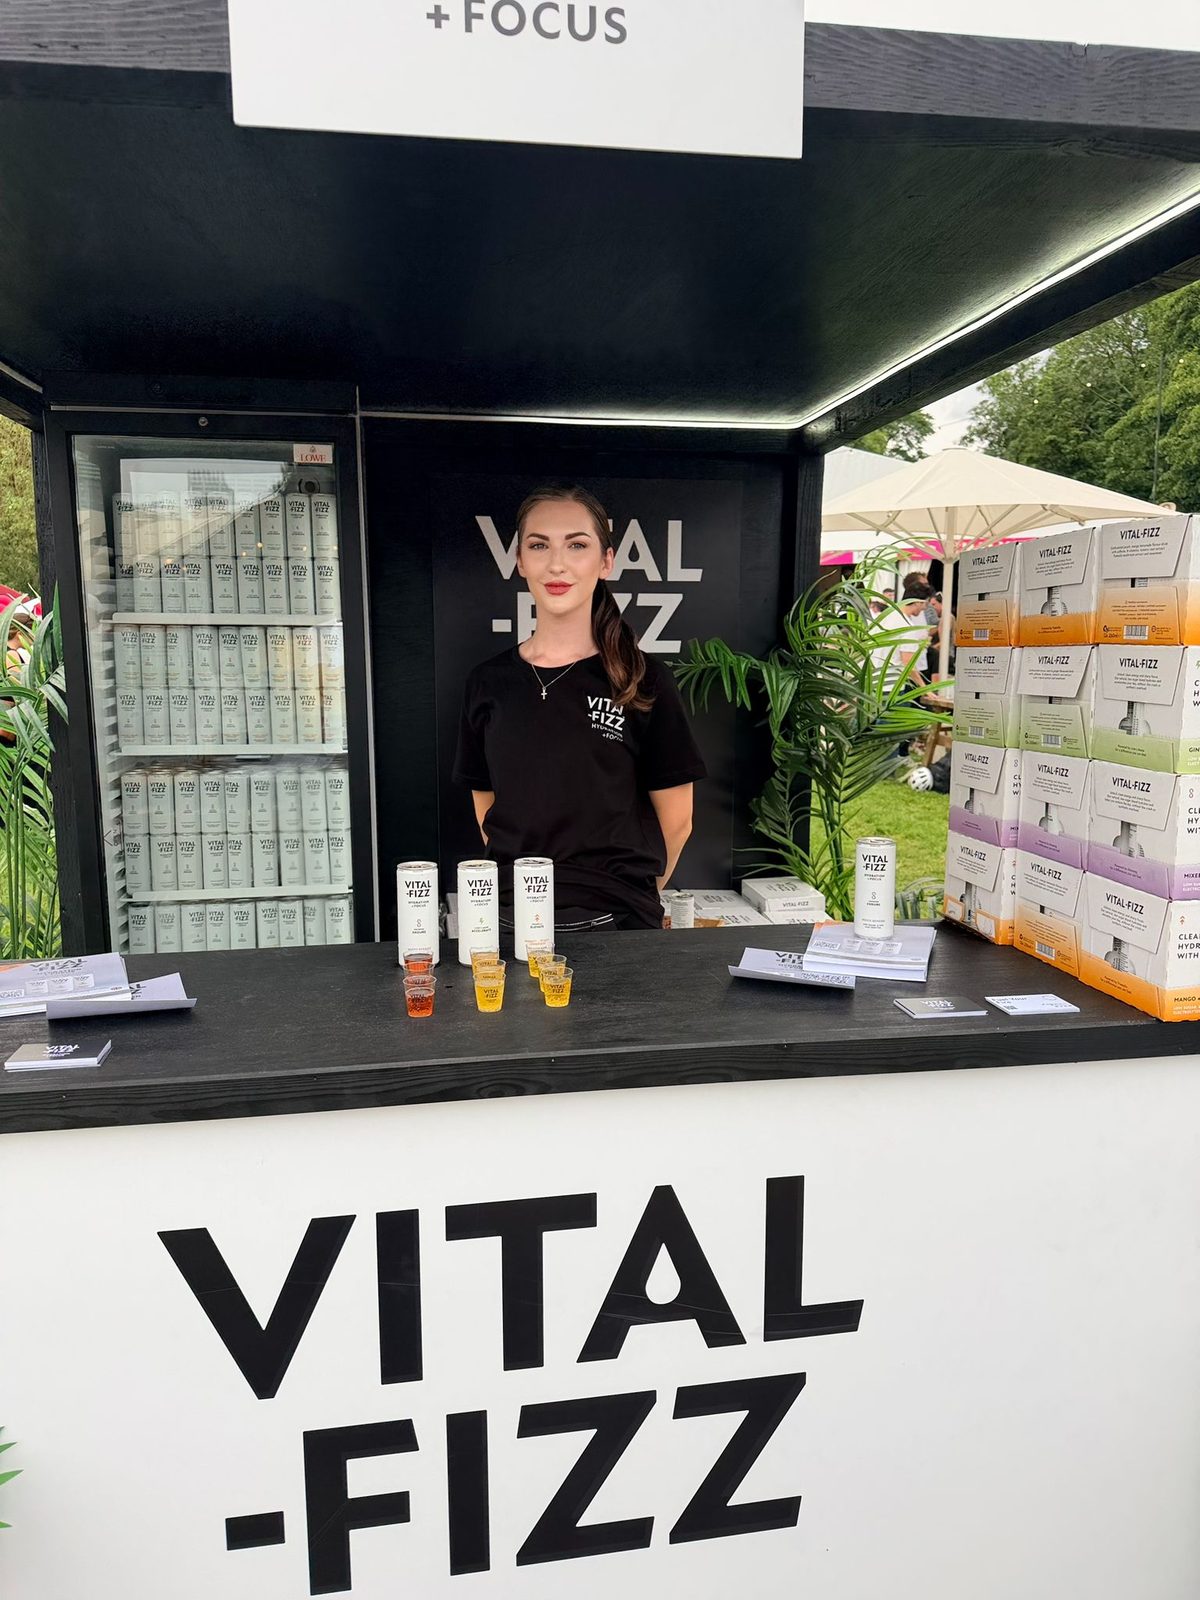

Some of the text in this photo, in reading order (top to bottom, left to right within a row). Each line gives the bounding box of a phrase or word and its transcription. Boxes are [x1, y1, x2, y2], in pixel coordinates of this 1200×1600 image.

[1120, 526, 1161, 540] VITAL-FIZZ
[1039, 544, 1072, 558] VITAL-FIZZ
[972, 554, 999, 566] VITAL-FIZZ
[968, 655, 996, 665] VITAL-FIZZ
[1038, 655, 1070, 666] VITAL-FIZZ
[1118, 658, 1159, 670] VITAL-FIZZ
[588, 710, 625, 731] -FIZZ
[964, 752, 990, 765] VITAL-FIZZ
[1036, 764, 1070, 778] VITAL-FIZZ
[1112, 776, 1152, 793] VITAL-FIZZ
[862, 854, 888, 863] VITAL
[960, 845, 987, 862] VITAL-FIZZ
[1030, 862, 1063, 881] VITAL-FIZZ
[404, 880, 432, 889] VITAL
[467, 879, 494, 887] VITAL
[523, 876, 550, 884] VITAL
[406, 889, 430, 898] -FIZZ
[469, 888, 492, 896] -FIZZ
[525, 884, 548, 893] -FIZZ
[1105, 892, 1144, 915] VITAL-FIZZ
[157, 1174, 865, 1401] VITAL
[225, 1371, 807, 1597] -FIZZ
